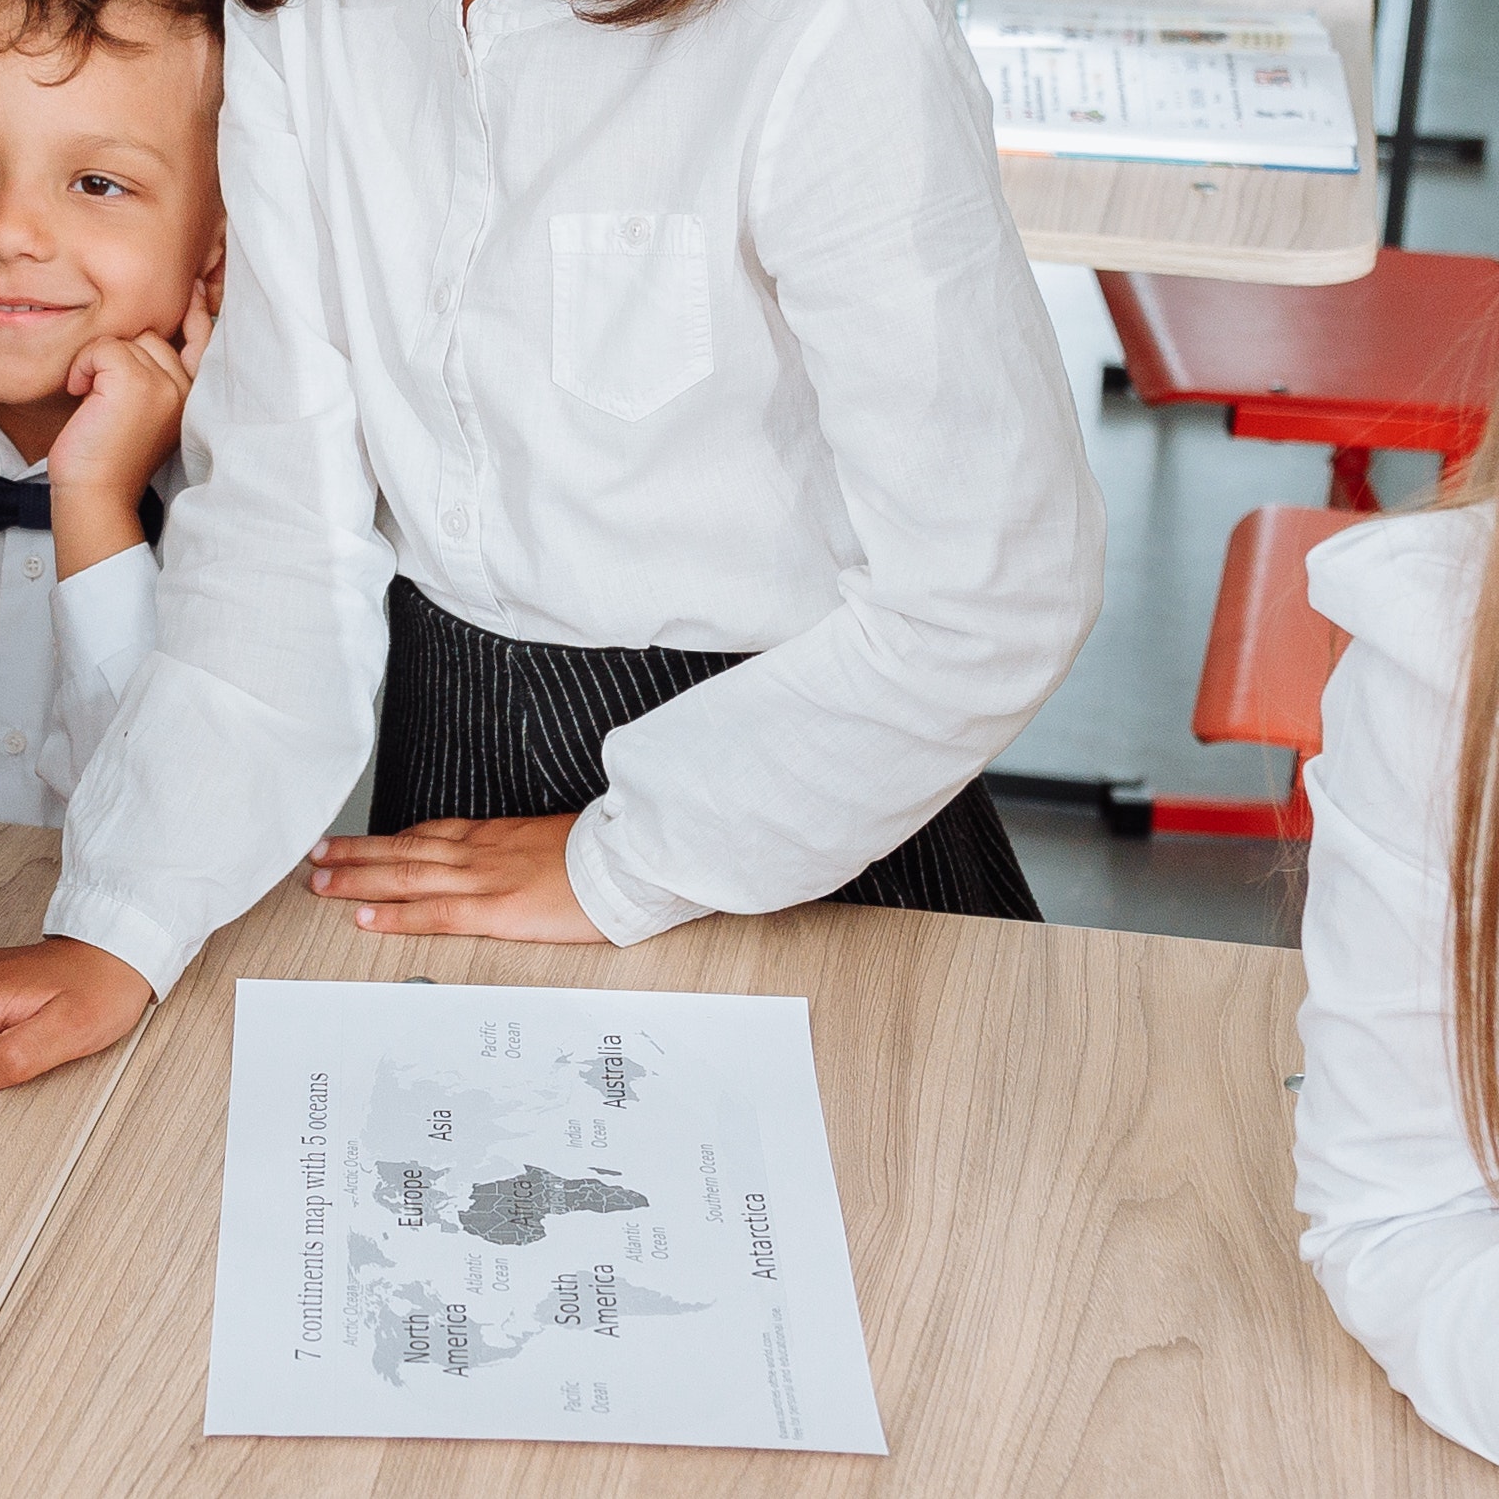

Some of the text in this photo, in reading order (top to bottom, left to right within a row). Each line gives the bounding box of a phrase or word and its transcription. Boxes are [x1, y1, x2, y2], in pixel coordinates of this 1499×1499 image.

[479, 1020, 497, 1059] Pacific
[504, 1021, 522, 1059] Ocean
[597, 1035, 628, 1110] Australia
[427, 1109, 453, 1142] Asia
[564, 1118, 583, 1149] Indian
[591, 1118, 608, 1149] Ocean
[343, 1168, 358, 1195] Arctic
[398, 1169, 431, 1227] Europe
[699, 1143, 724, 1223] Southern Ocean
[295, 1072, 333, 1360] 7 continents map with 5 oceans
[507, 1180, 534, 1227] Africa
[624, 1222, 643, 1264] Atlantic
[651, 1226, 669, 1260] Ocean
[741, 1193, 778, 1280] Antarctica
[464, 1252, 484, 1295] Atlantic
[492, 1257, 510, 1292] Ocean
[343, 1285, 358, 1347] Arctic Ocean
[550, 1273, 581, 1326] South
[588, 1264, 621, 1339] America
[402, 1313, 431, 1364] North
[439, 1303, 469, 1378] America
[560, 1381, 581, 1413] Pacific
[591, 1382, 610, 1415] Ocean
